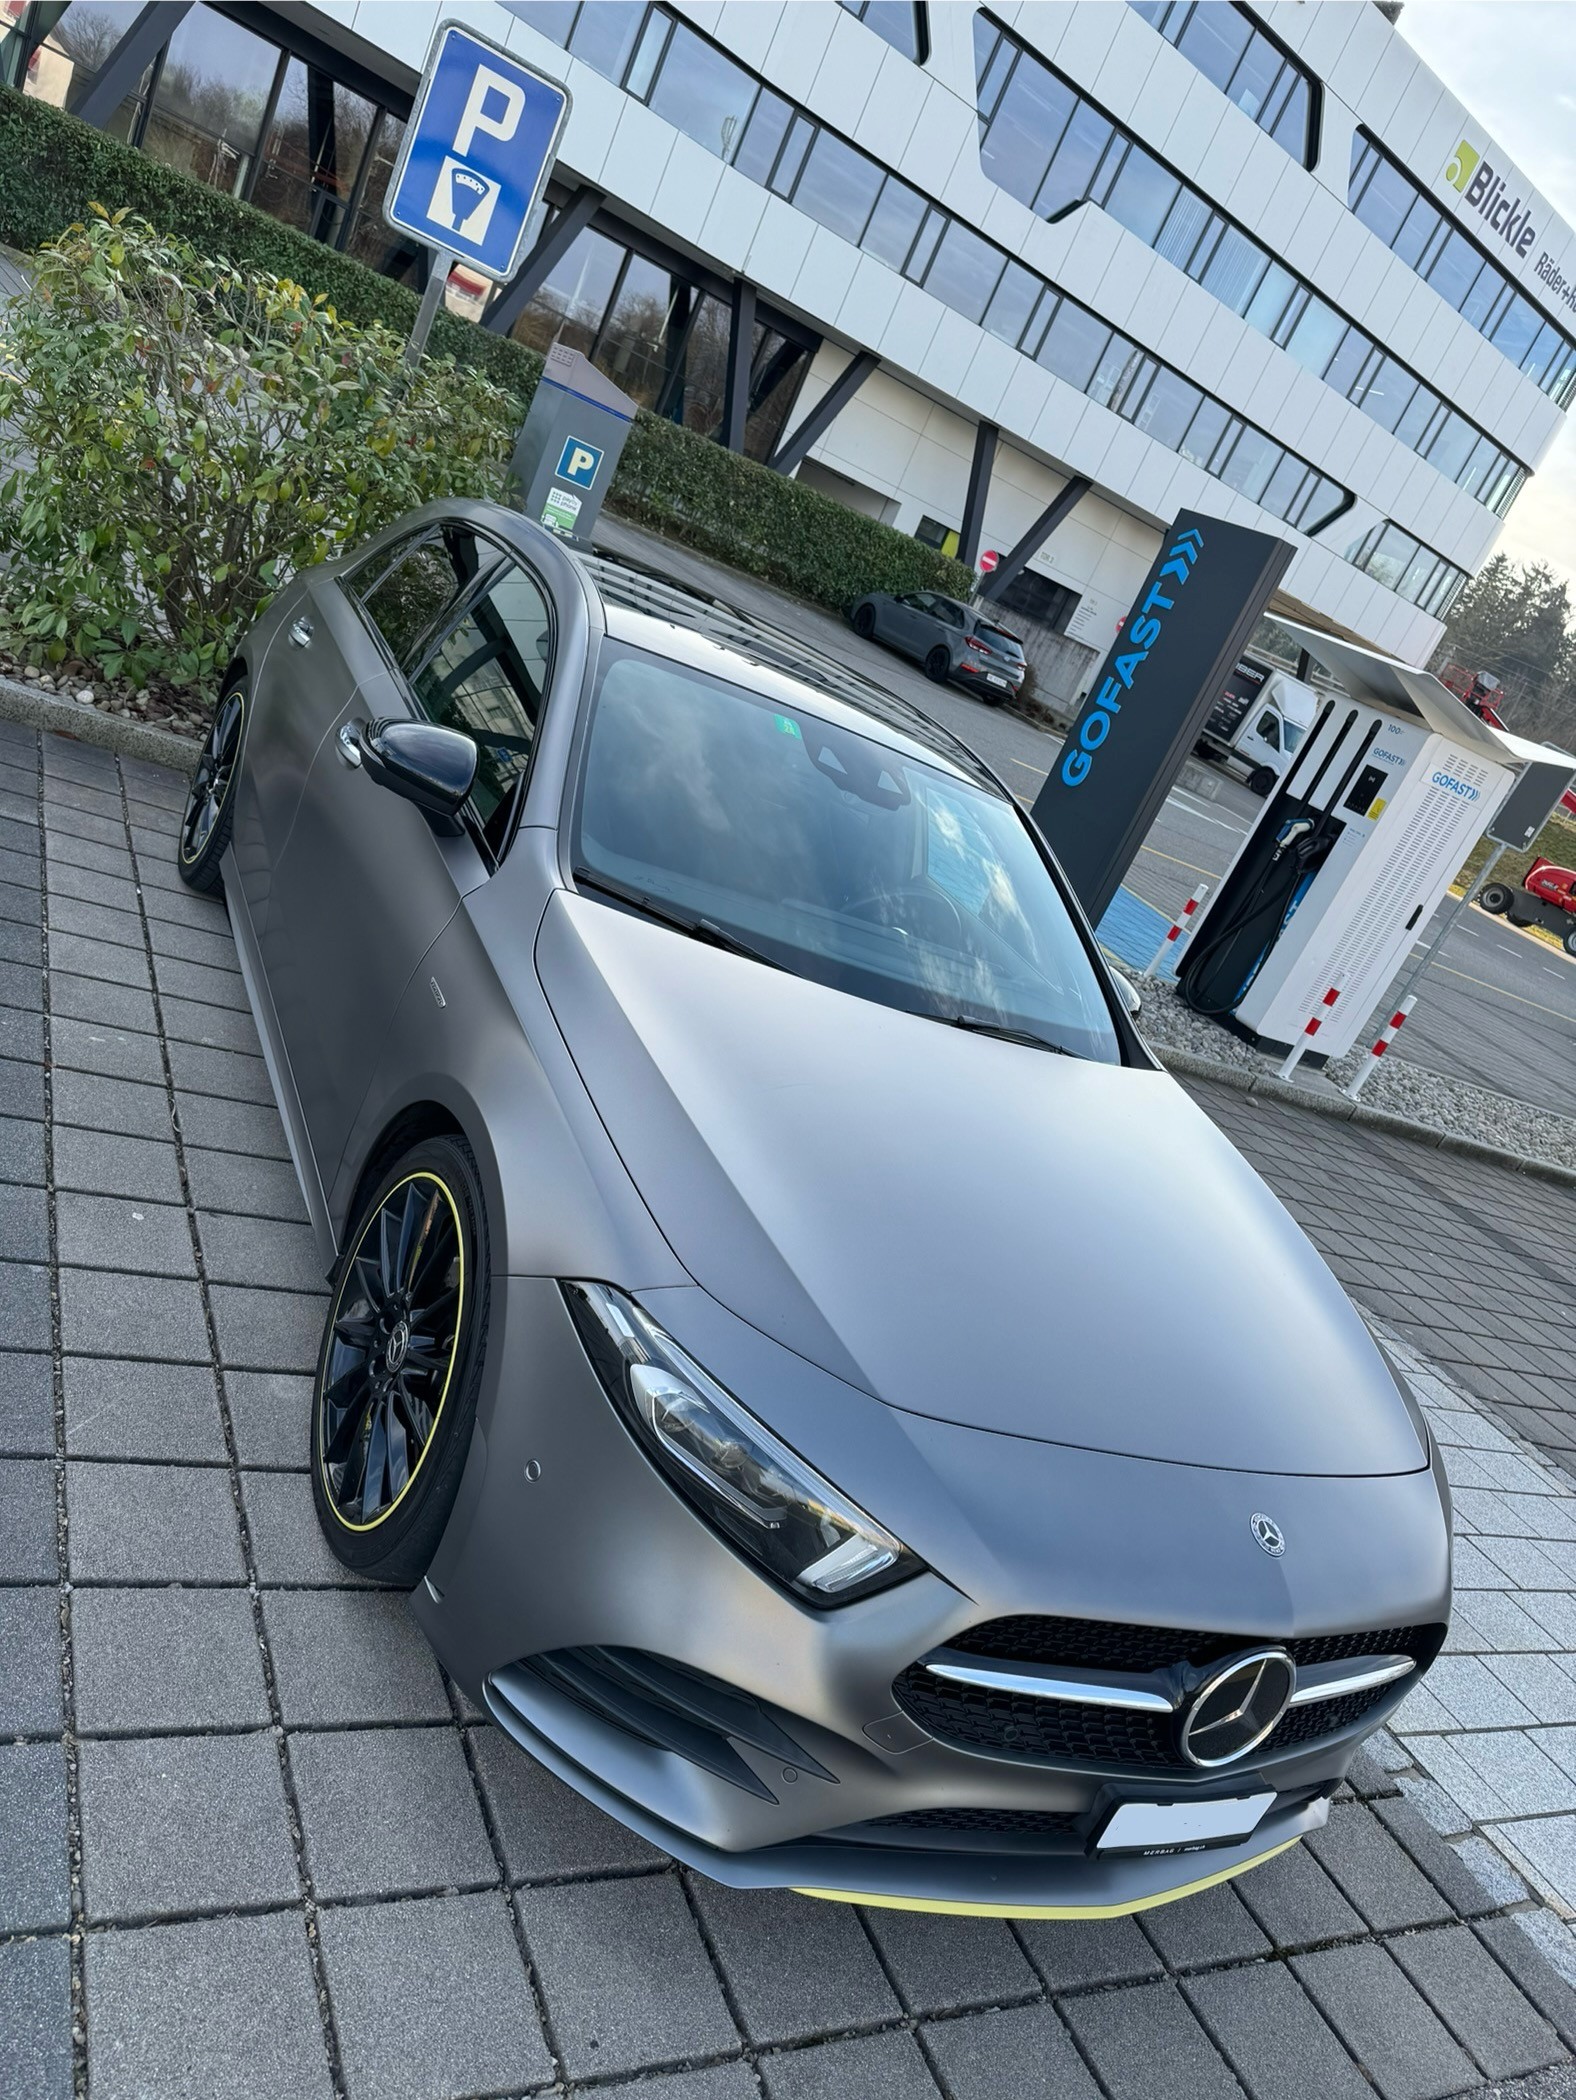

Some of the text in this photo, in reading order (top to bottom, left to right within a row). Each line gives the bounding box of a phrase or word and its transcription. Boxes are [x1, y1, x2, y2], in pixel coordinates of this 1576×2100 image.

[452, 64, 526, 157] P
[1464, 161, 1536, 259] Blickle
[567, 447, 594, 476] P
[1061, 581, 1175, 787] GOFAST
[1373, 747, 1401, 765] GOFAST
[1432, 772, 1473, 800] GOFAST
